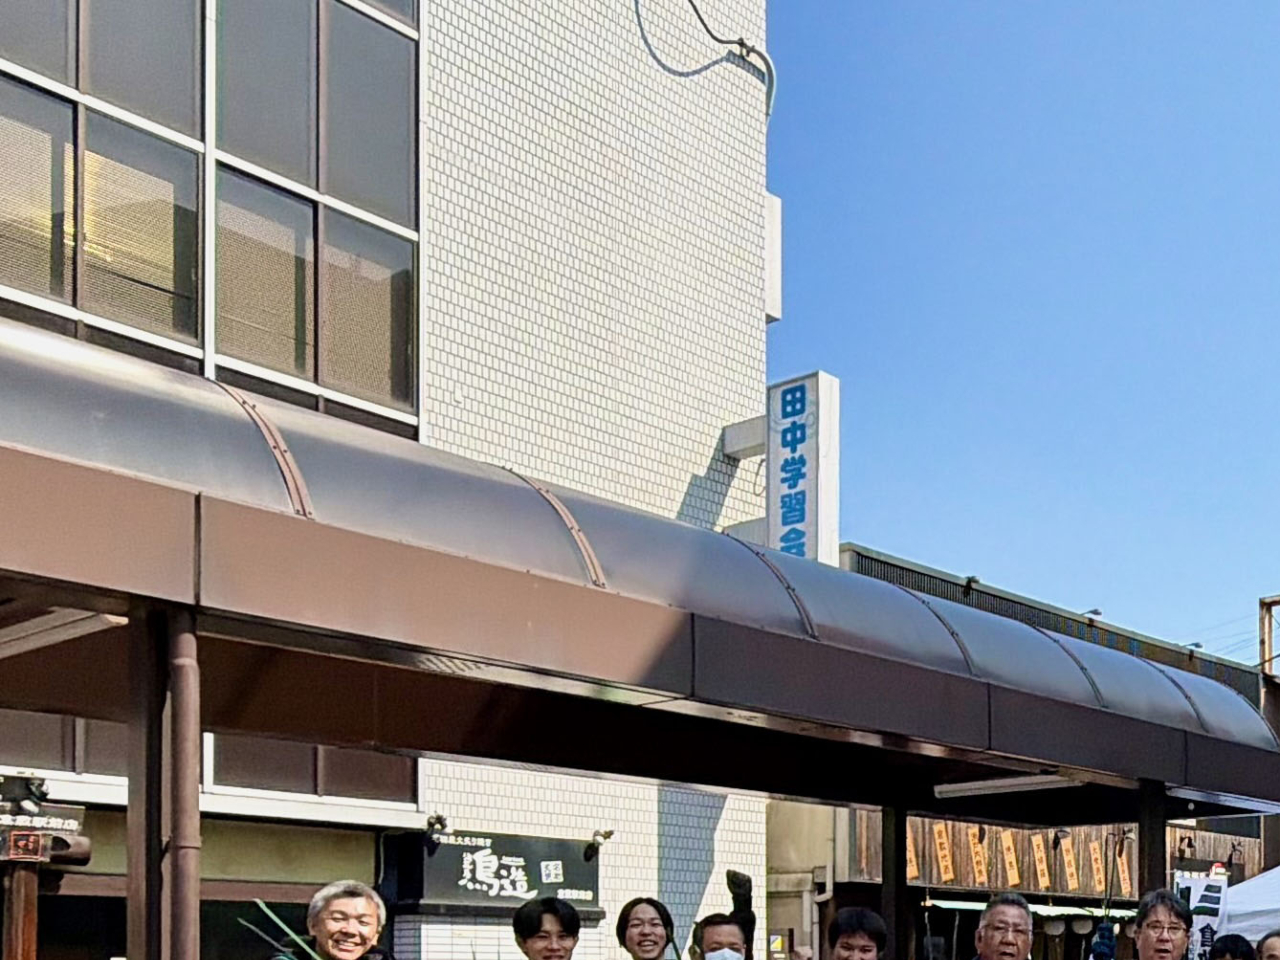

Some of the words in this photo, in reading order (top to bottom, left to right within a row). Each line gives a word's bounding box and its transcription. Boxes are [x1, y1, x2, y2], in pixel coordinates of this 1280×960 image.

[781, 383, 807, 557] 田中学習会
